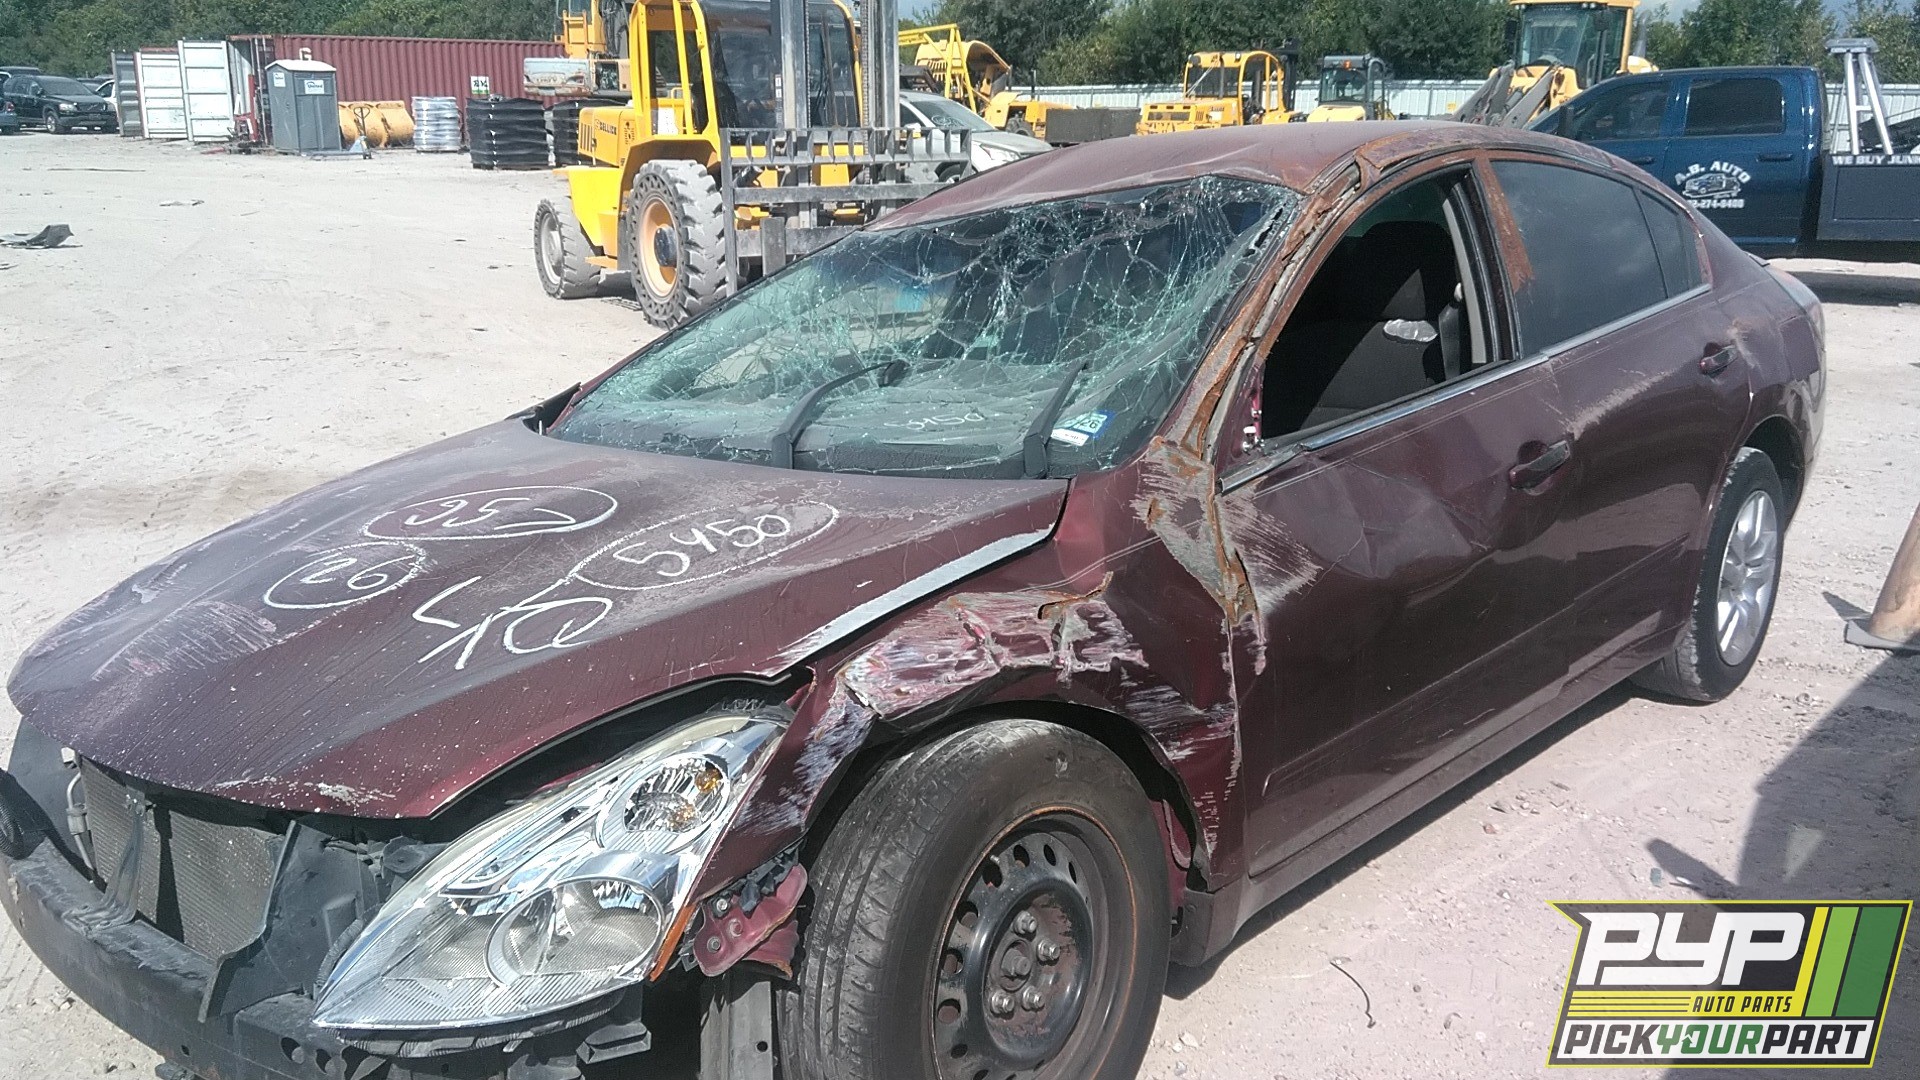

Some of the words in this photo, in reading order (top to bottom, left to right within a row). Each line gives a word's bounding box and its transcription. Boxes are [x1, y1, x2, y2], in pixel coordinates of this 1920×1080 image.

[1675, 163, 1706, 186] A.B.
[1709, 160, 1751, 184] AUTO
[1832, 155, 1853, 165] WE
[1855, 155, 1885, 165] BUY
[612, 513, 791, 577] 5450
[300, 555, 416, 591] 26
